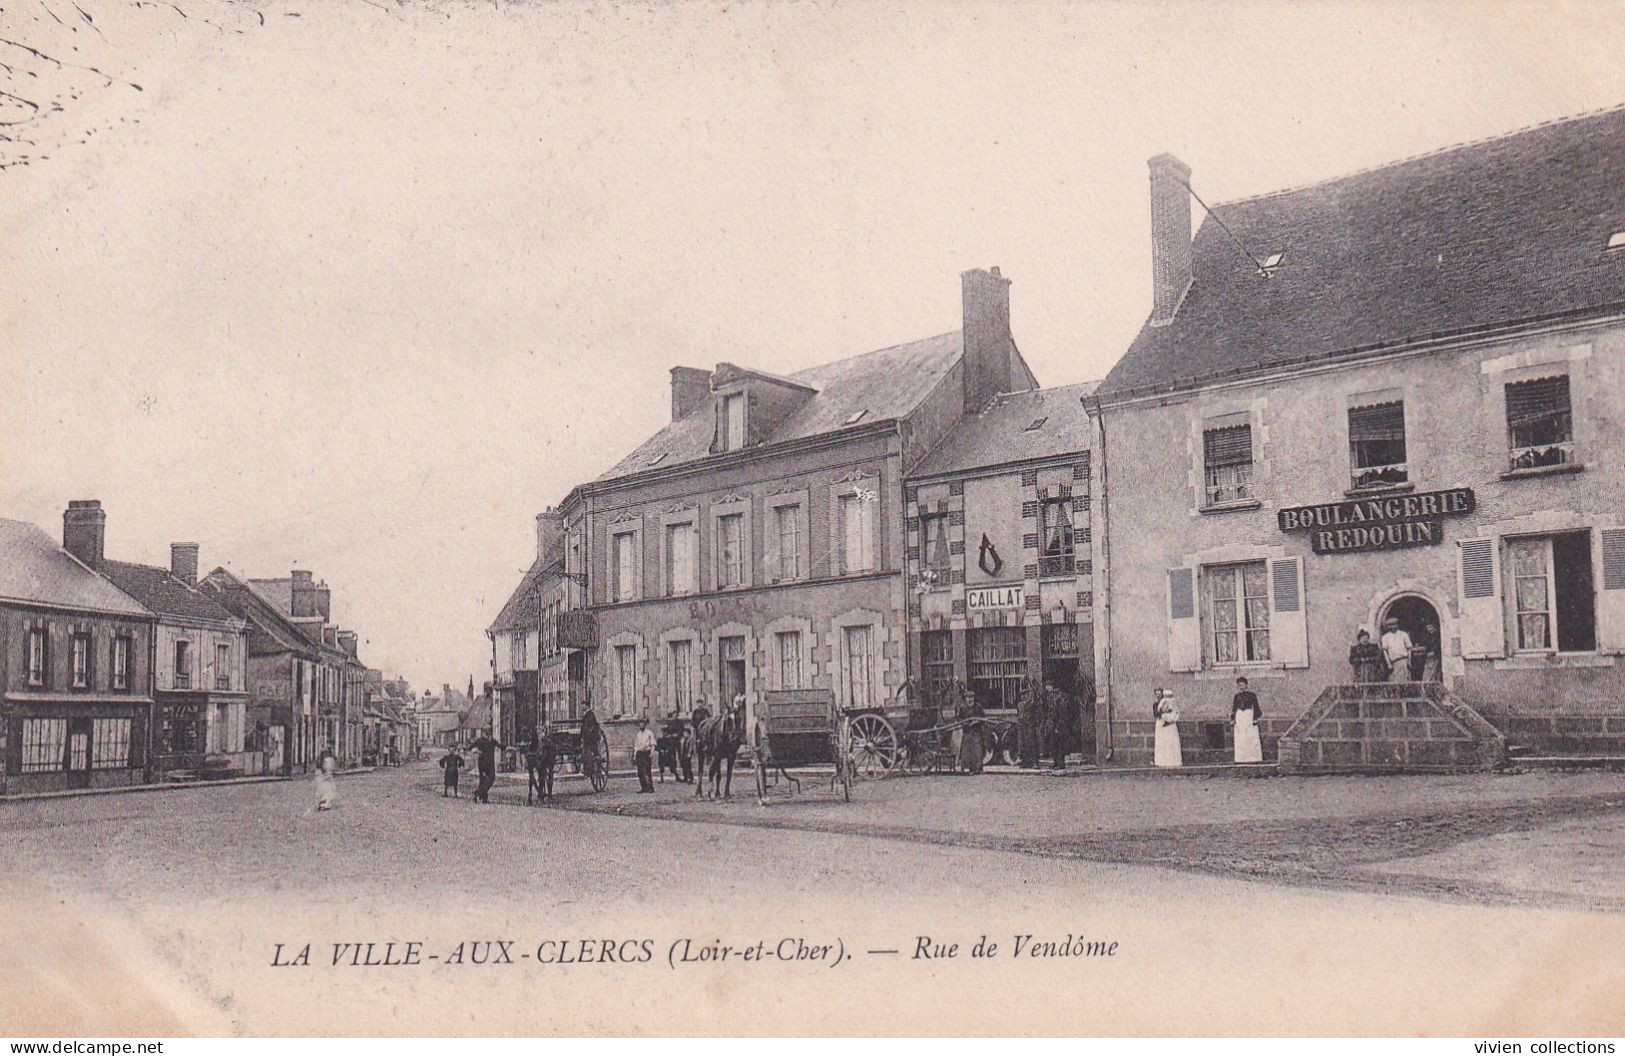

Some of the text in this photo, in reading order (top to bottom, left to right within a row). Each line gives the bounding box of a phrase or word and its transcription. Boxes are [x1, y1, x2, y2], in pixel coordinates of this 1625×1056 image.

[1283, 491, 1468, 530] BOULANGERIE
[1318, 521, 1434, 551] REDOUIN
[968, 588, 1022, 608] CAILLAT
